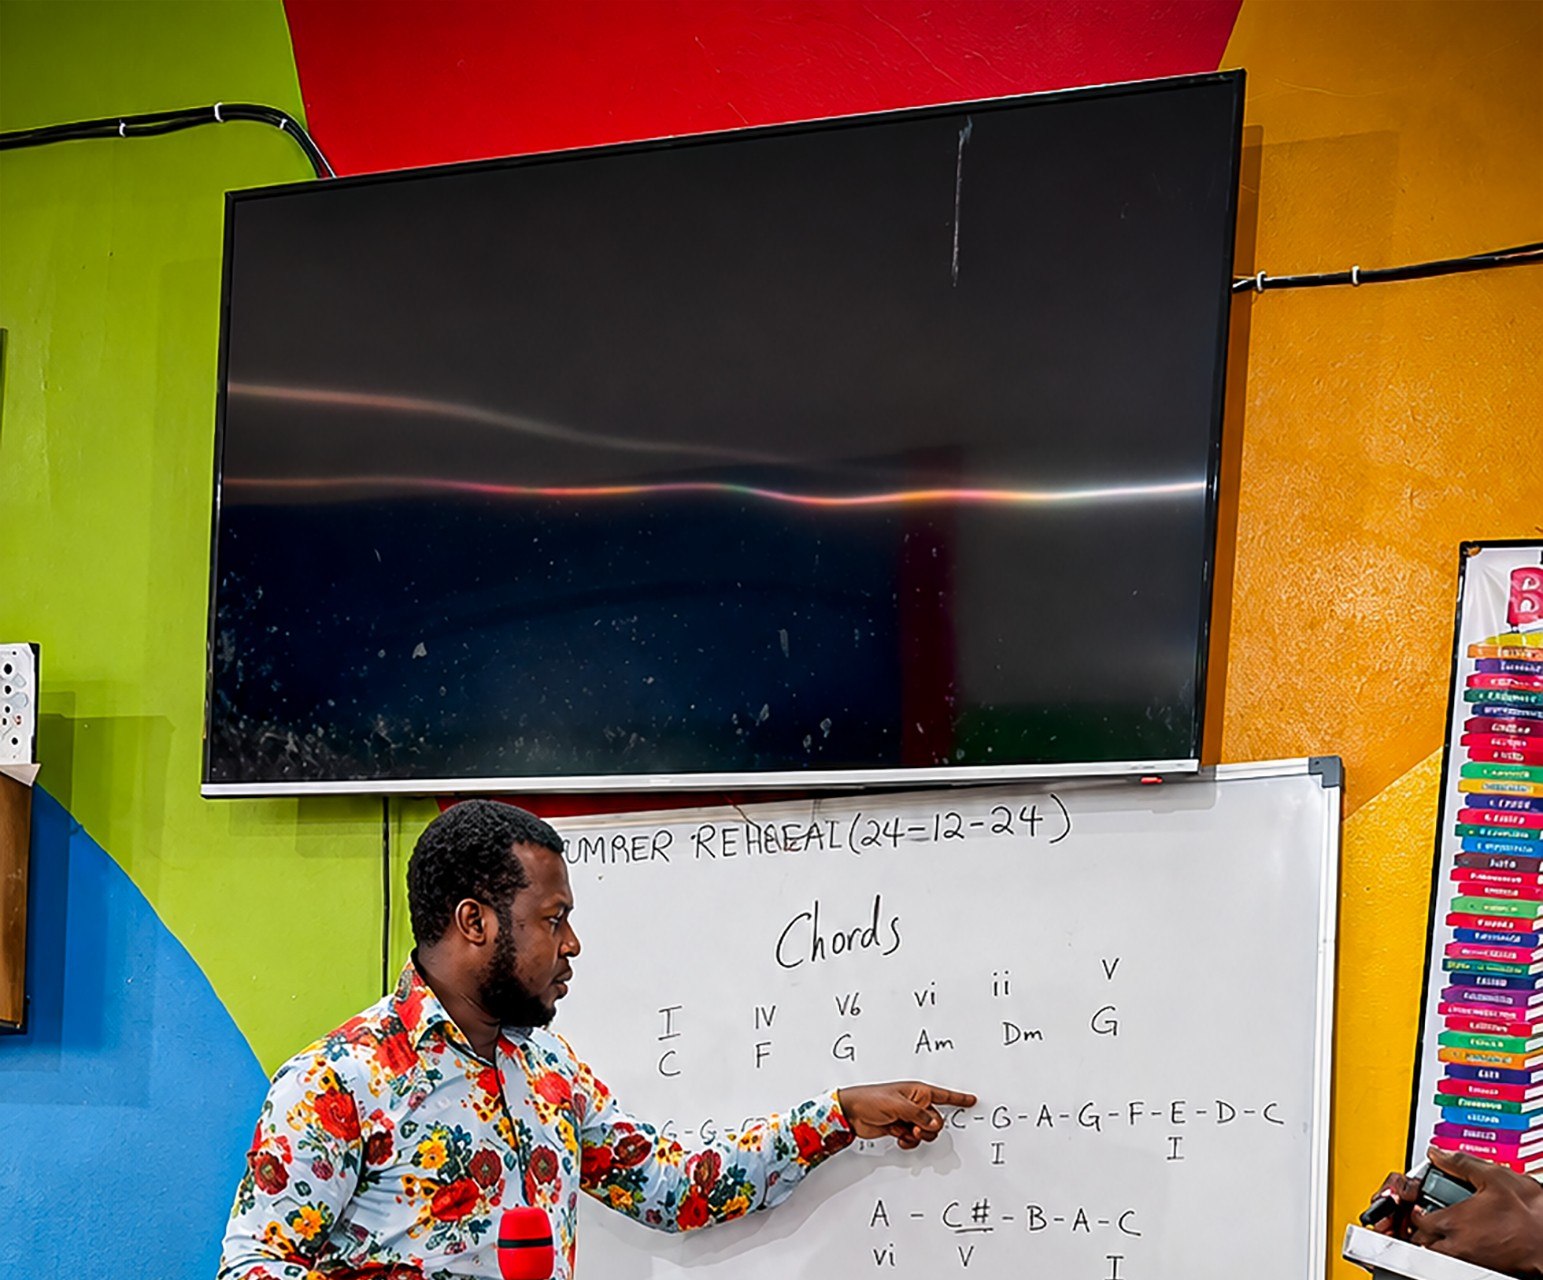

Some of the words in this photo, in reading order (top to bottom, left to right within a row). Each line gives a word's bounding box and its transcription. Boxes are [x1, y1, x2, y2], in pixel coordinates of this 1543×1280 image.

[775, 894, 901, 969] Chords
[658, 1050, 682, 1077] C
[755, 1041, 772, 1069] F
[832, 1033, 855, 1062] G
[914, 1028, 954, 1055] Am
[1002, 1021, 1044, 1046] Dm
[1090, 1005, 1118, 1037] G
[755, 1004, 777, 1030] IV
